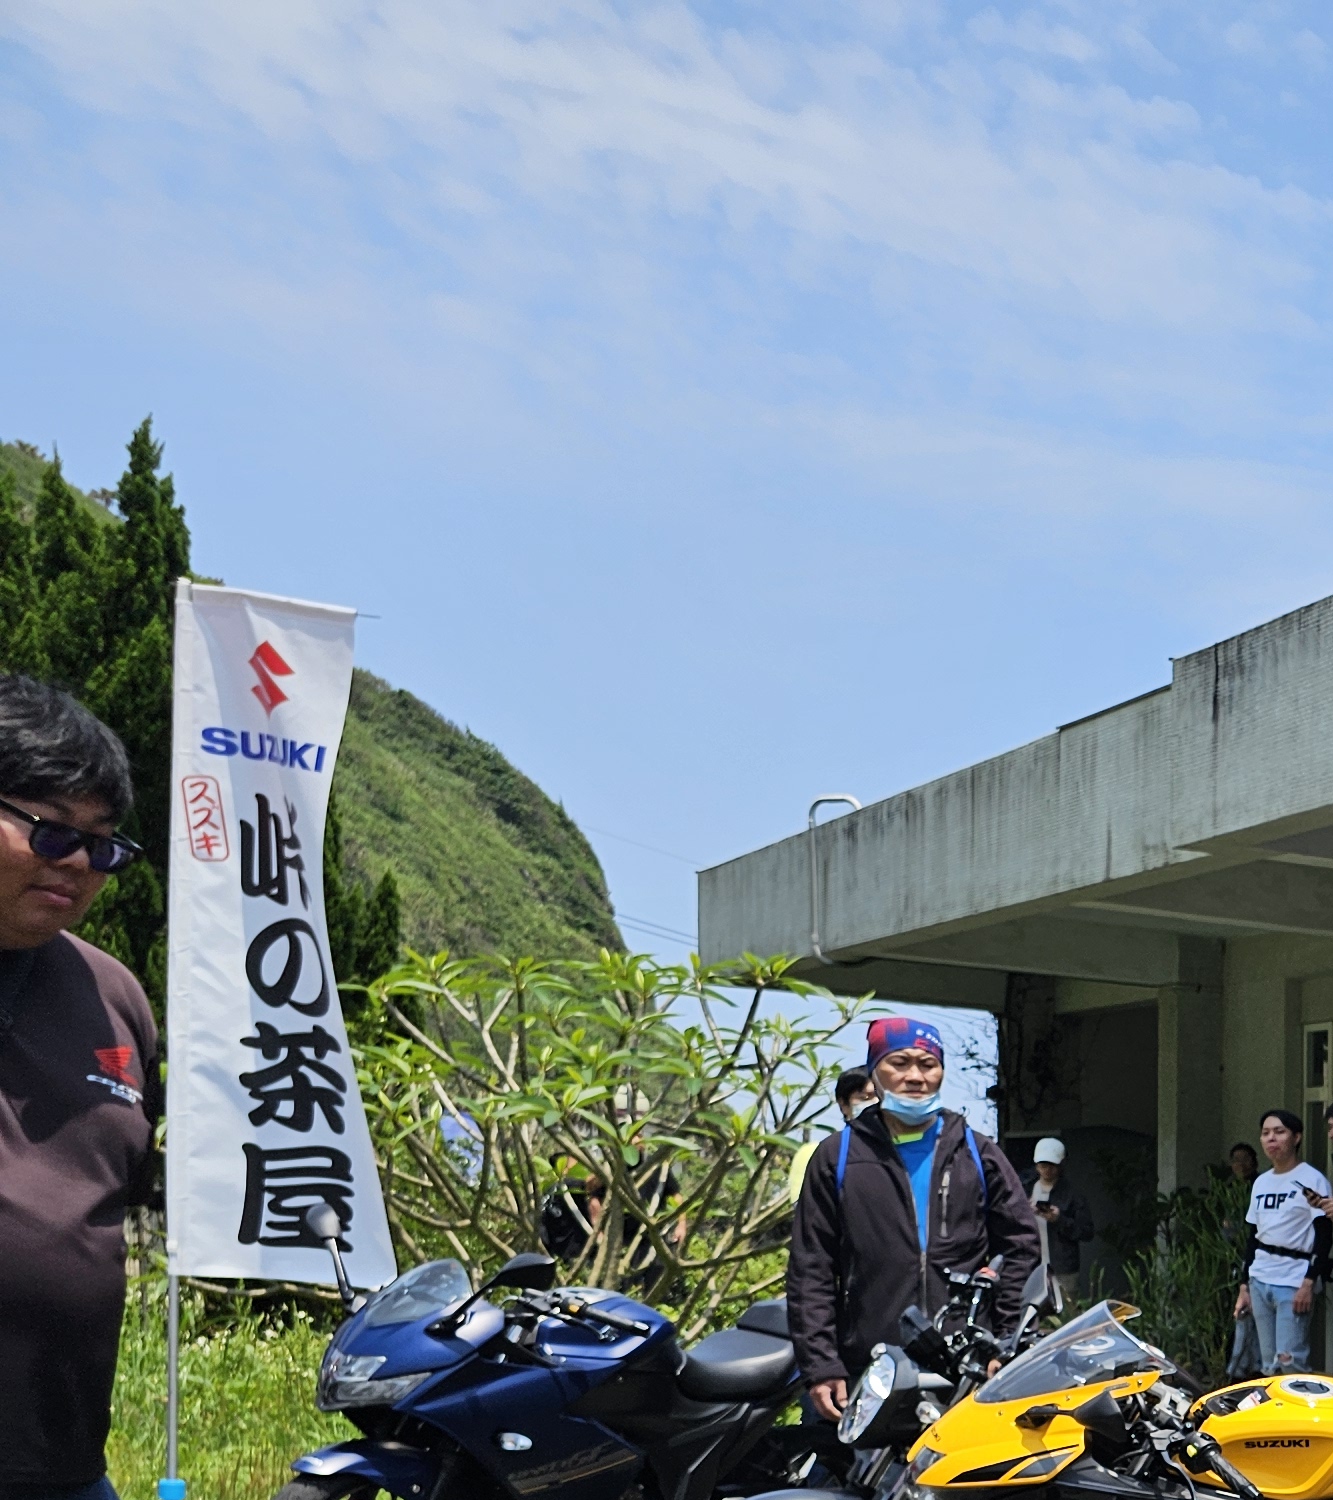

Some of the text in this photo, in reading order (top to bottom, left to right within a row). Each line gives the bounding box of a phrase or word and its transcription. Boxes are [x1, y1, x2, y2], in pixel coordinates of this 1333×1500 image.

[201, 727, 327, 773] SUZUKI
[188, 781, 222, 857] スズキ
[238, 793, 355, 1253] 峠の茶屋
[1244, 1439, 1310, 1449] SUZUKI
